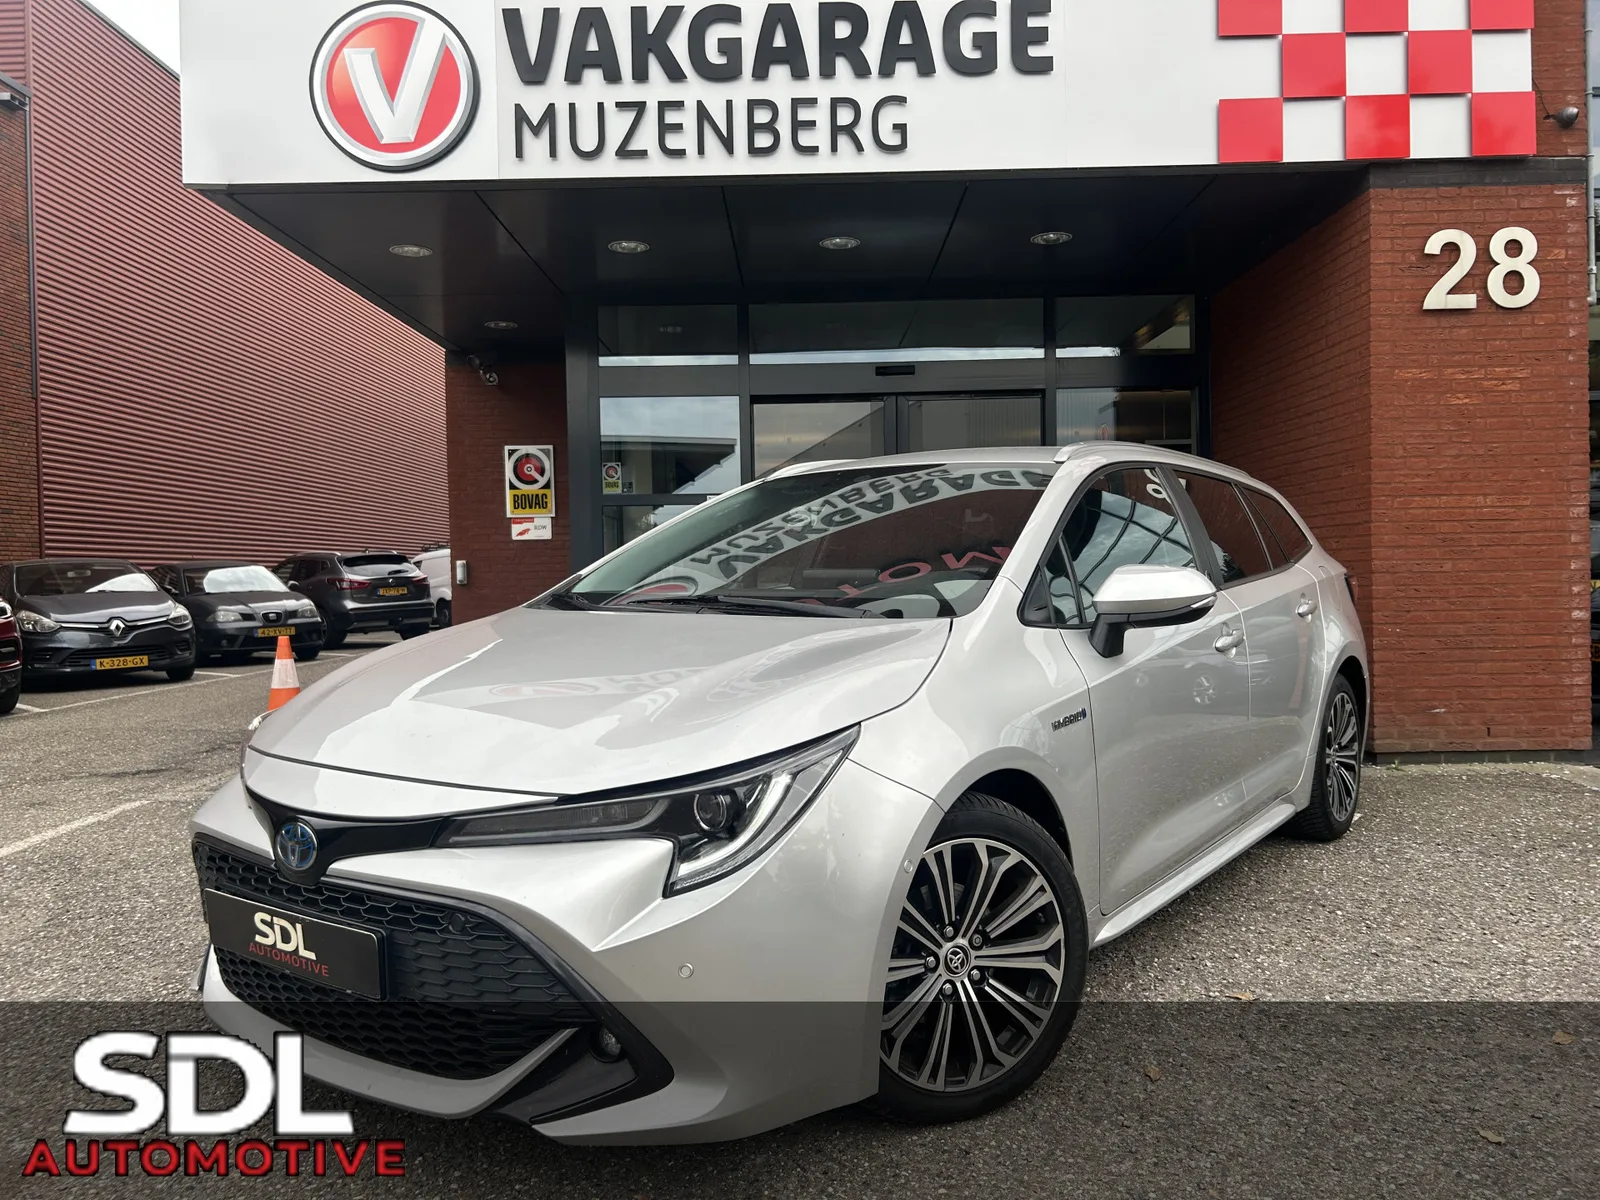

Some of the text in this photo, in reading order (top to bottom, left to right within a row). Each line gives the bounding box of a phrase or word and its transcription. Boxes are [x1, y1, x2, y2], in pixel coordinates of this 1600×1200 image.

[501, 0, 1054, 85] VAKGARAGE
[515, 95, 909, 161] MUZENBERG
[1423, 227, 1541, 310] 28
[513, 493, 548, 510] BOVAG
[99, 656, 146, 669] K-328-GX
[1051, 711, 1082, 732] HYBRID
[253, 910, 316, 960] SDL
[249, 941, 329, 977] AUTOMOTIVE
